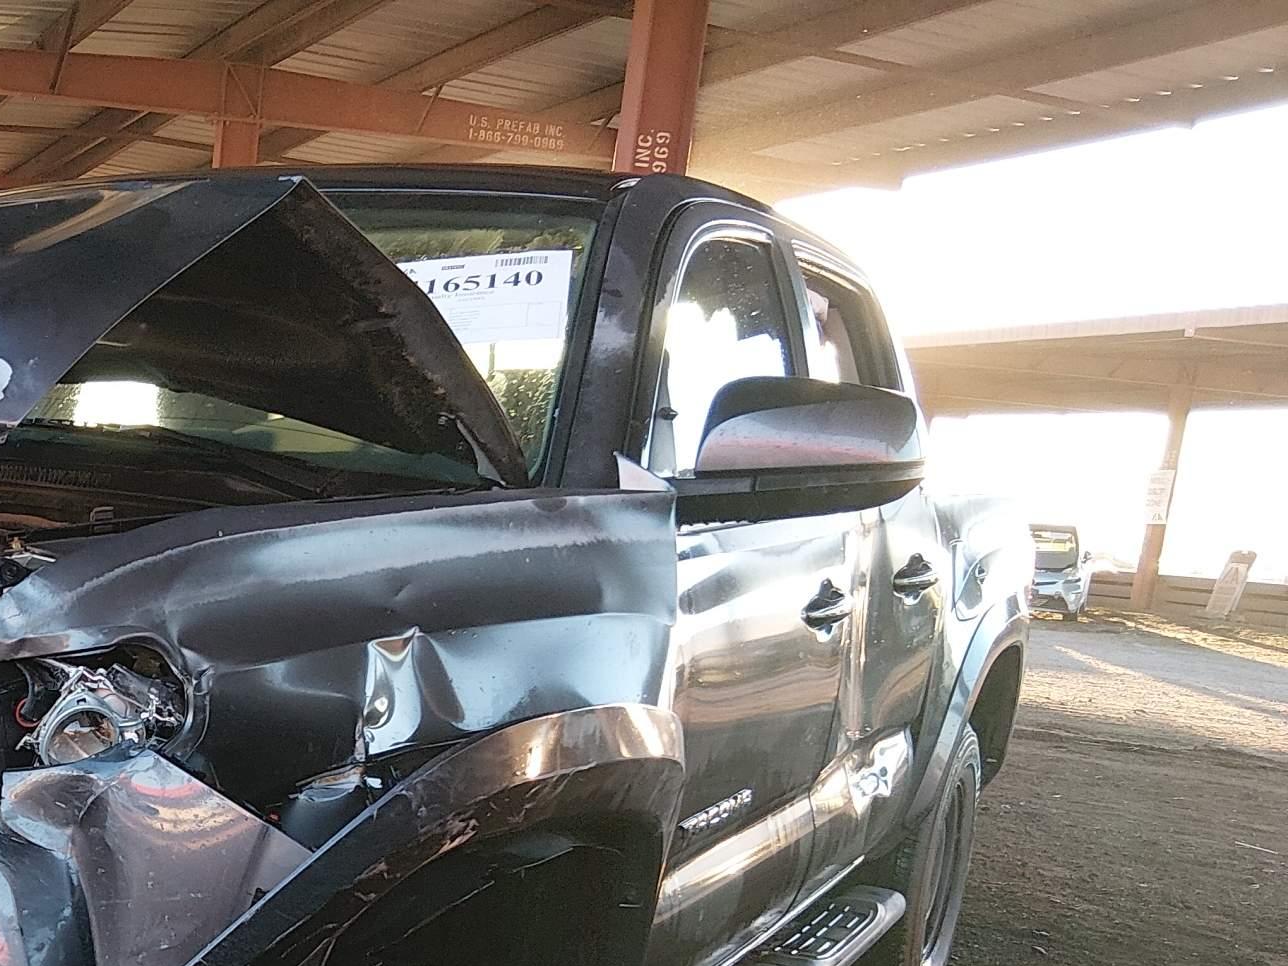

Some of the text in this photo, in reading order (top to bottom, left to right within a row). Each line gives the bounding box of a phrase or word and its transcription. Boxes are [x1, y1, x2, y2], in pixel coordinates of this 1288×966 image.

[469, 114, 566, 138] U.S. PREFAB INC.
[634, 129, 654, 168] INC.
[652, 132, 671, 173] 969
[414, 269, 543, 294] 165140
